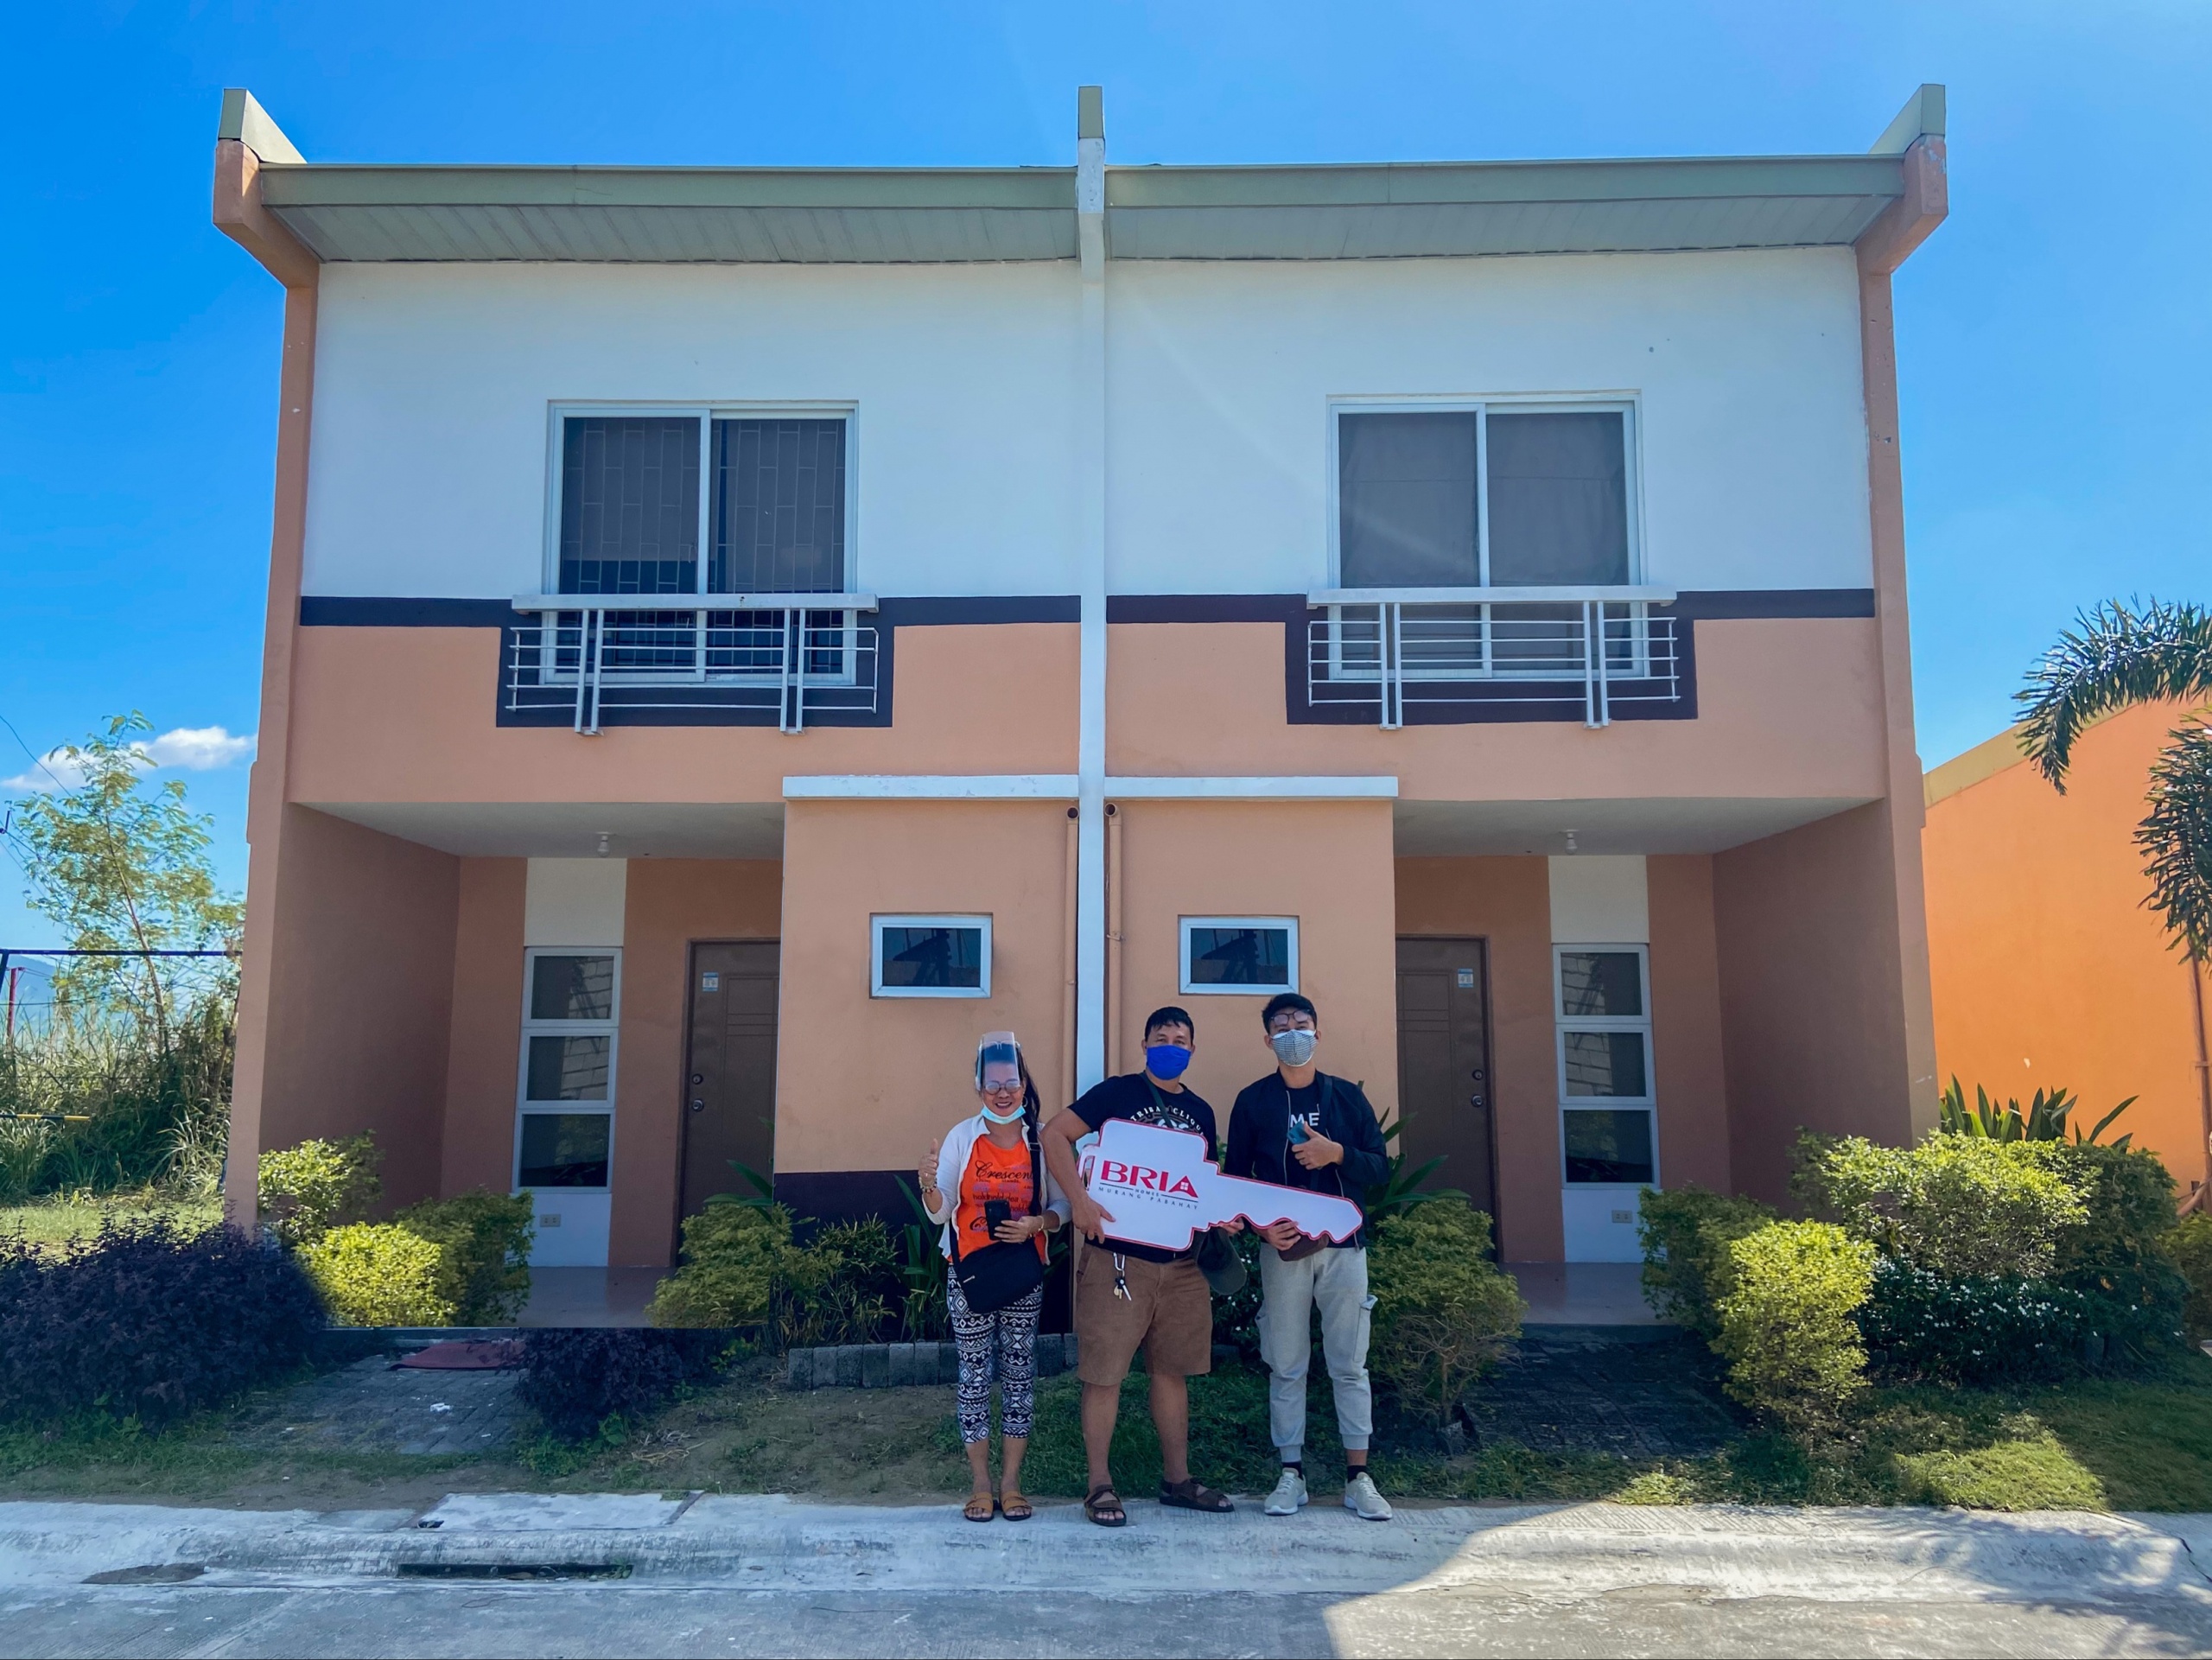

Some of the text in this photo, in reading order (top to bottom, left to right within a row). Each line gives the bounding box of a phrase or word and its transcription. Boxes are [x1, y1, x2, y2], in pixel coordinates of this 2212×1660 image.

[1130, 1106, 1161, 1122] TRIBA
[1290, 1112, 1320, 1129] ME
[1100, 1160, 1199, 1199] BRIA
[1098, 1186, 1198, 1211] MURANG PABAHAY
[1135, 1188, 1160, 1198] HOMES
